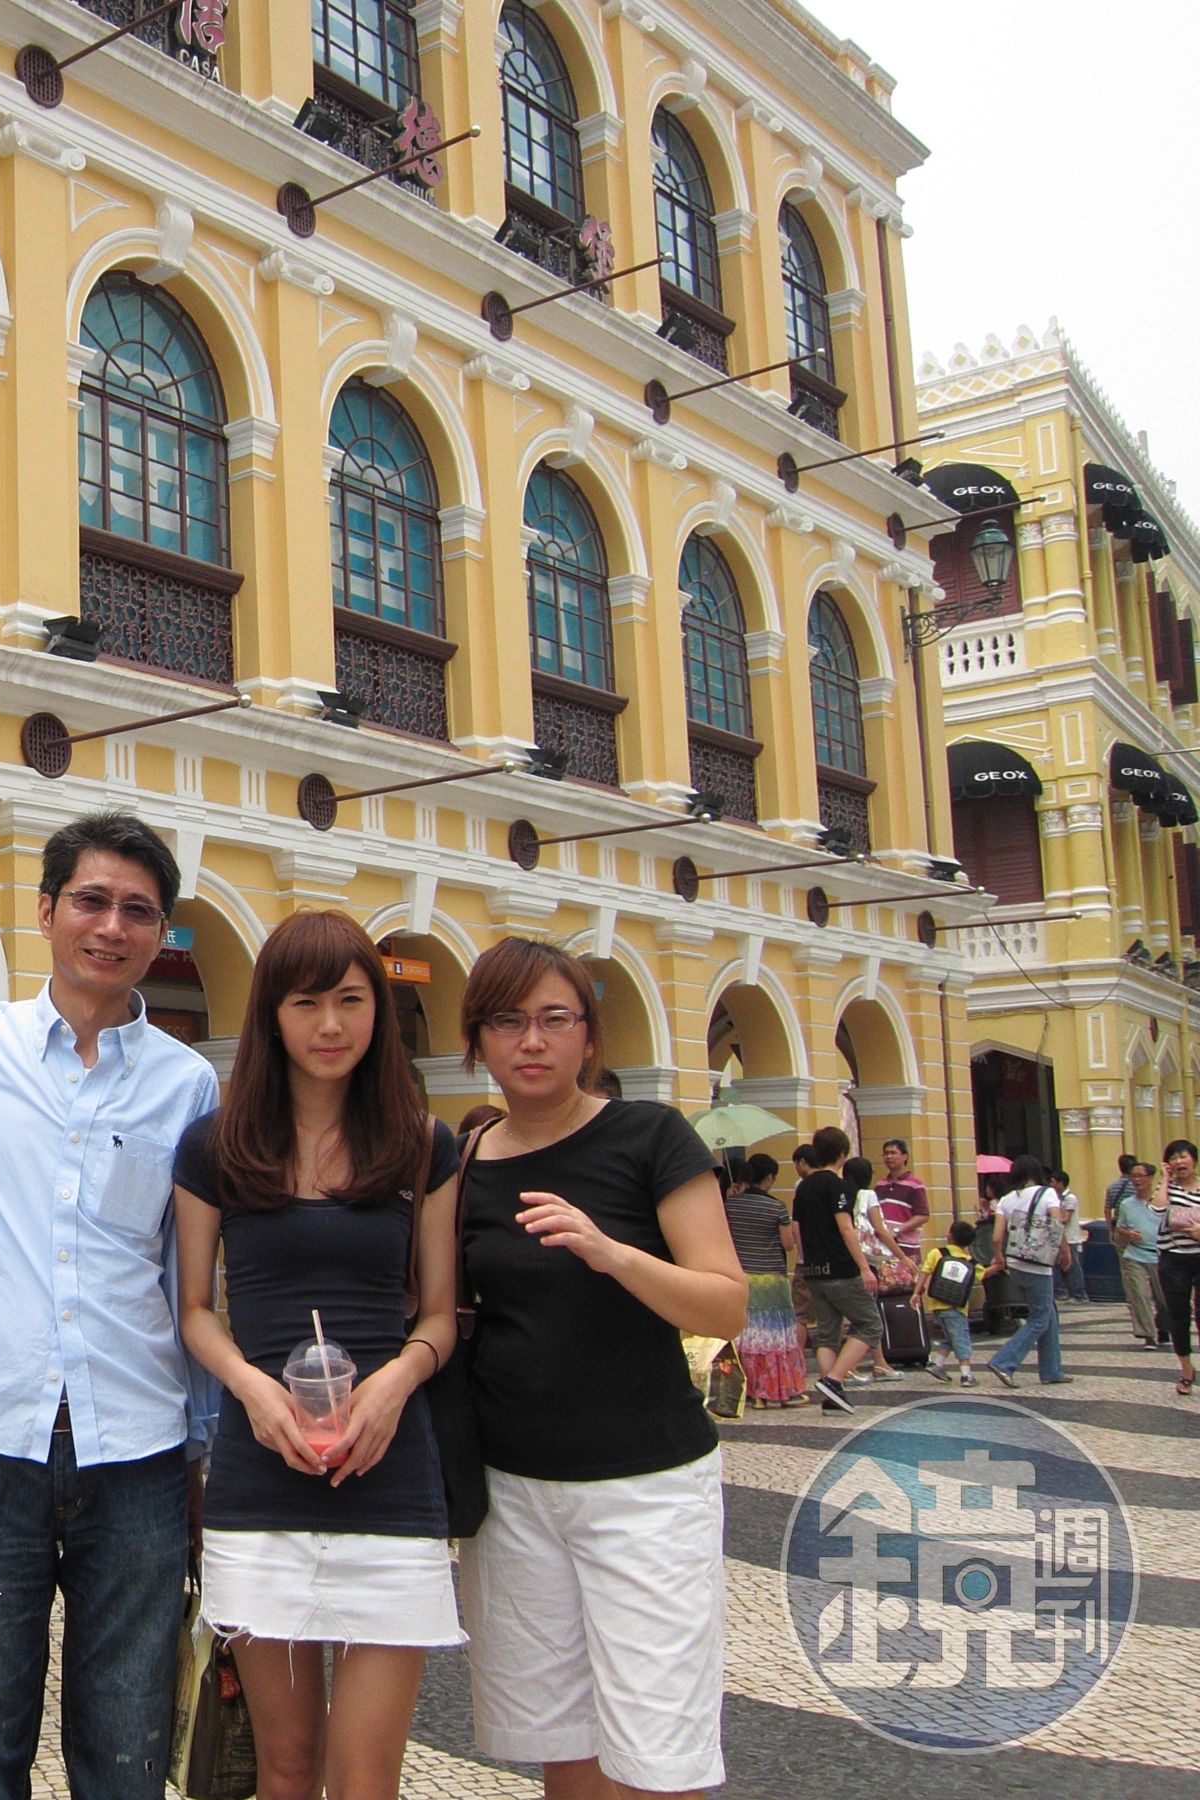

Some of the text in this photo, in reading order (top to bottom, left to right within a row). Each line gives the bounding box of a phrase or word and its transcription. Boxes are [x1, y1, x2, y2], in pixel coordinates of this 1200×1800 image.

[180, 48, 221, 82] CASA
[953, 485, 1006, 497] GEOX
[1092, 482, 1133, 494] GEOX
[974, 770, 1028, 781] GEOX
[1120, 767, 1161, 779] GEOX
